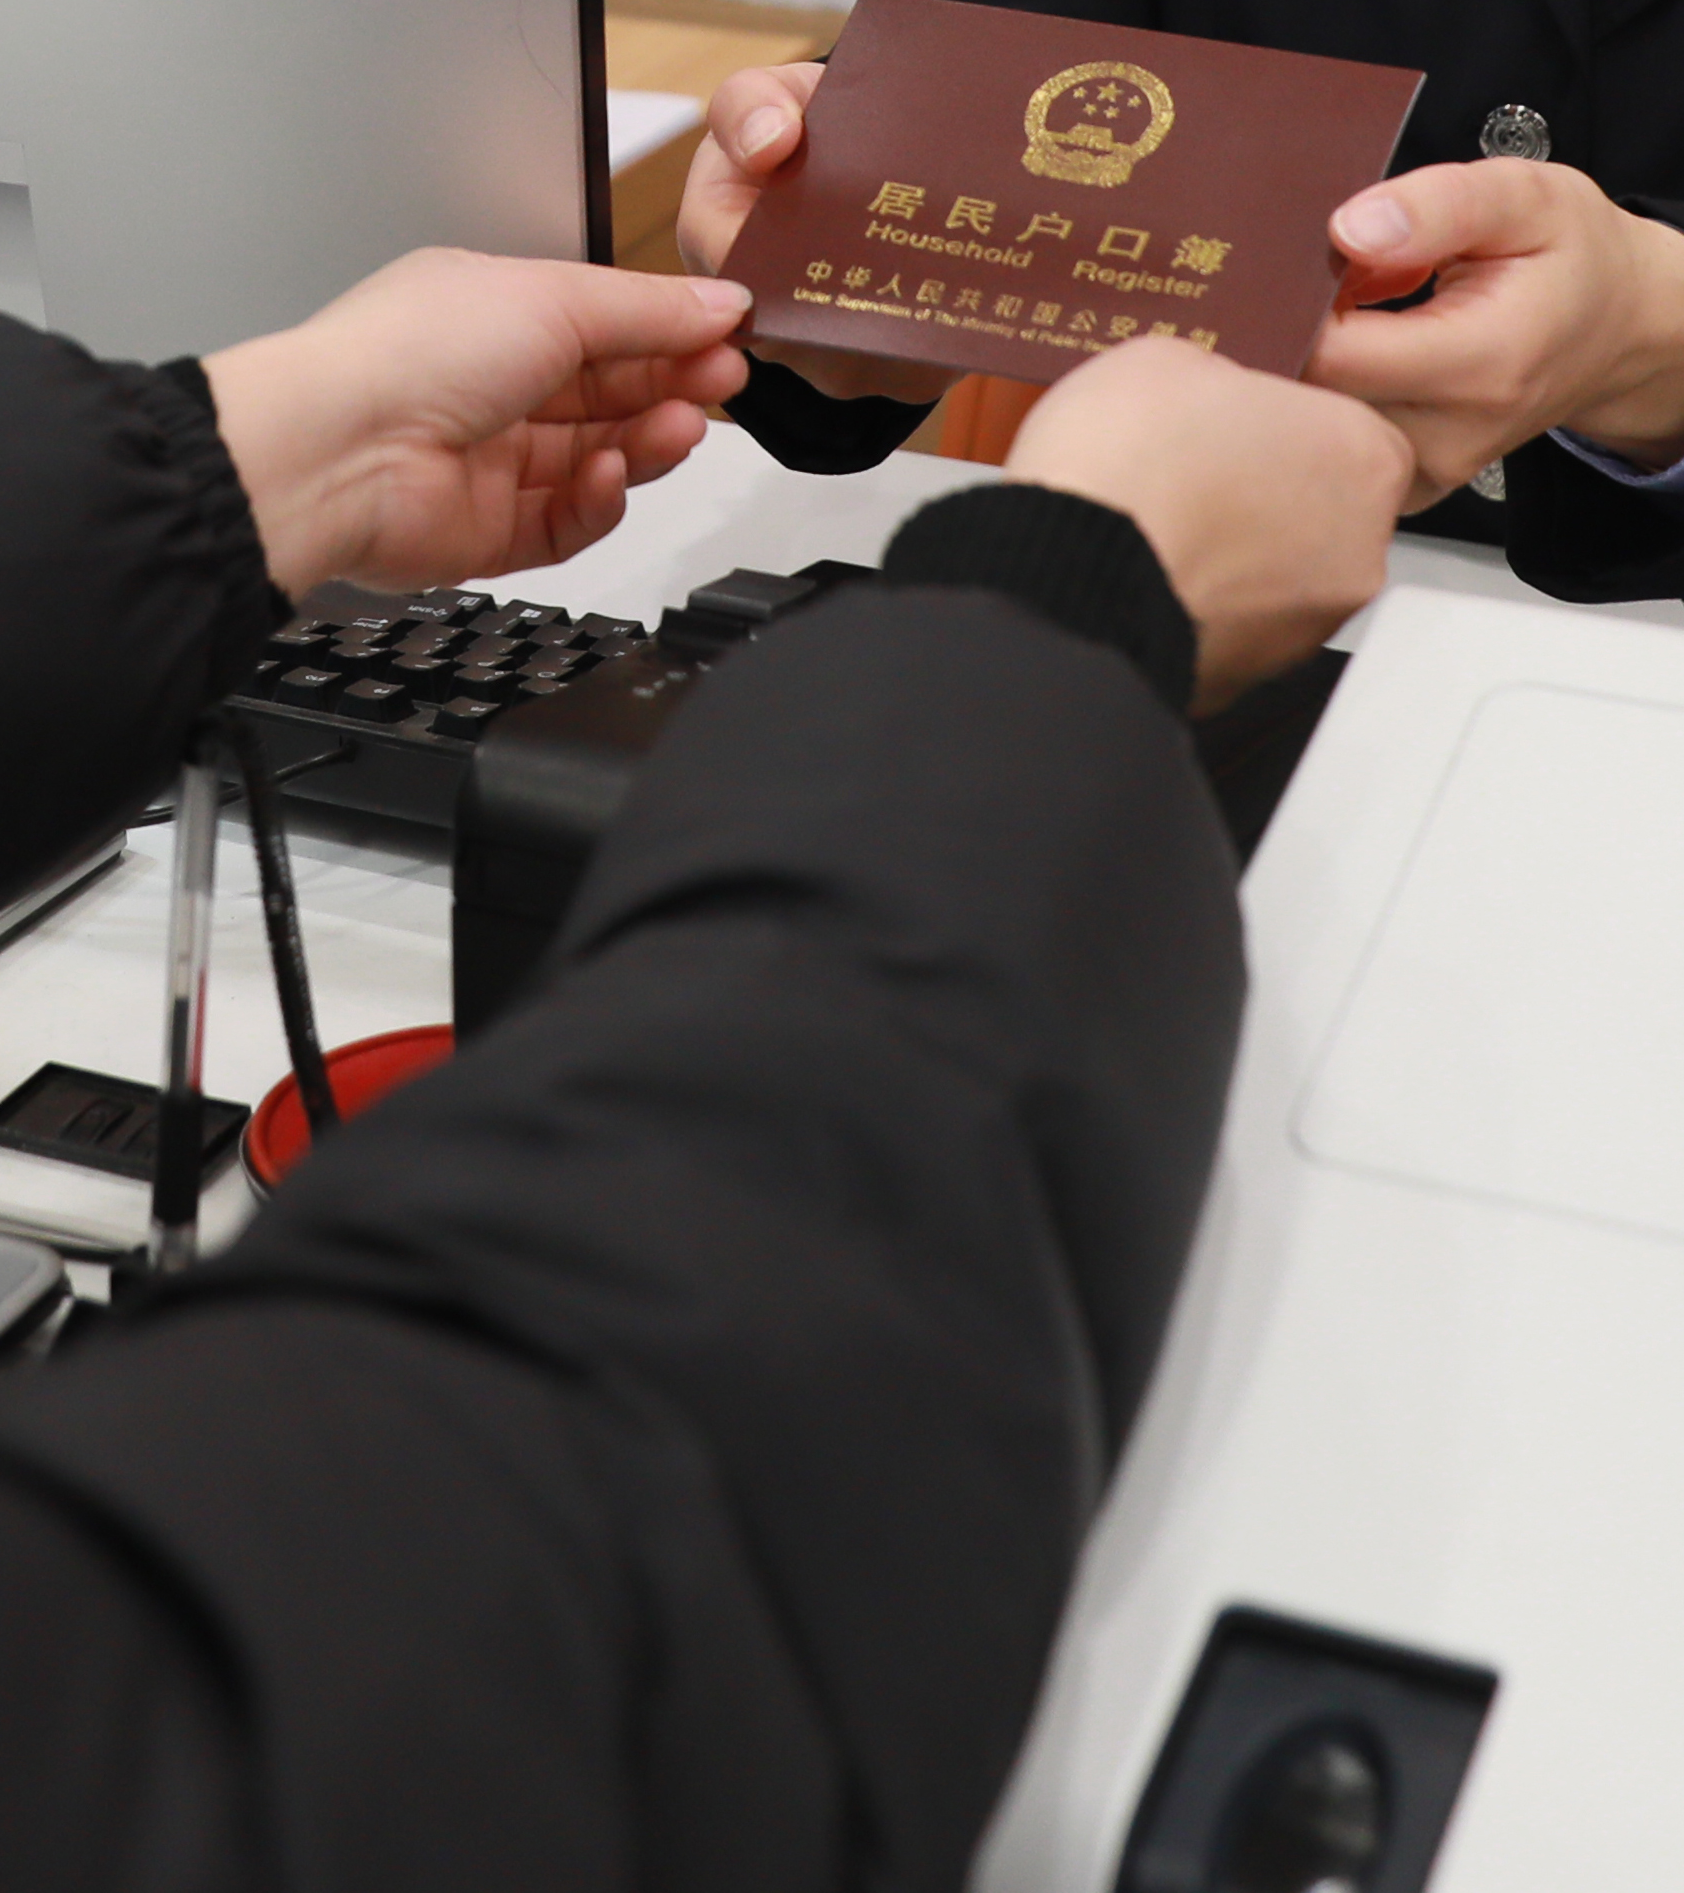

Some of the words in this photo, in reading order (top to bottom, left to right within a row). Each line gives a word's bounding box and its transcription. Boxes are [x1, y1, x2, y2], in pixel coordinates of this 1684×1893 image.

[864, 219, 1035, 269] Household
[1071, 259, 1210, 299] Register
[867, 180, 1233, 276] 居民户口簿
